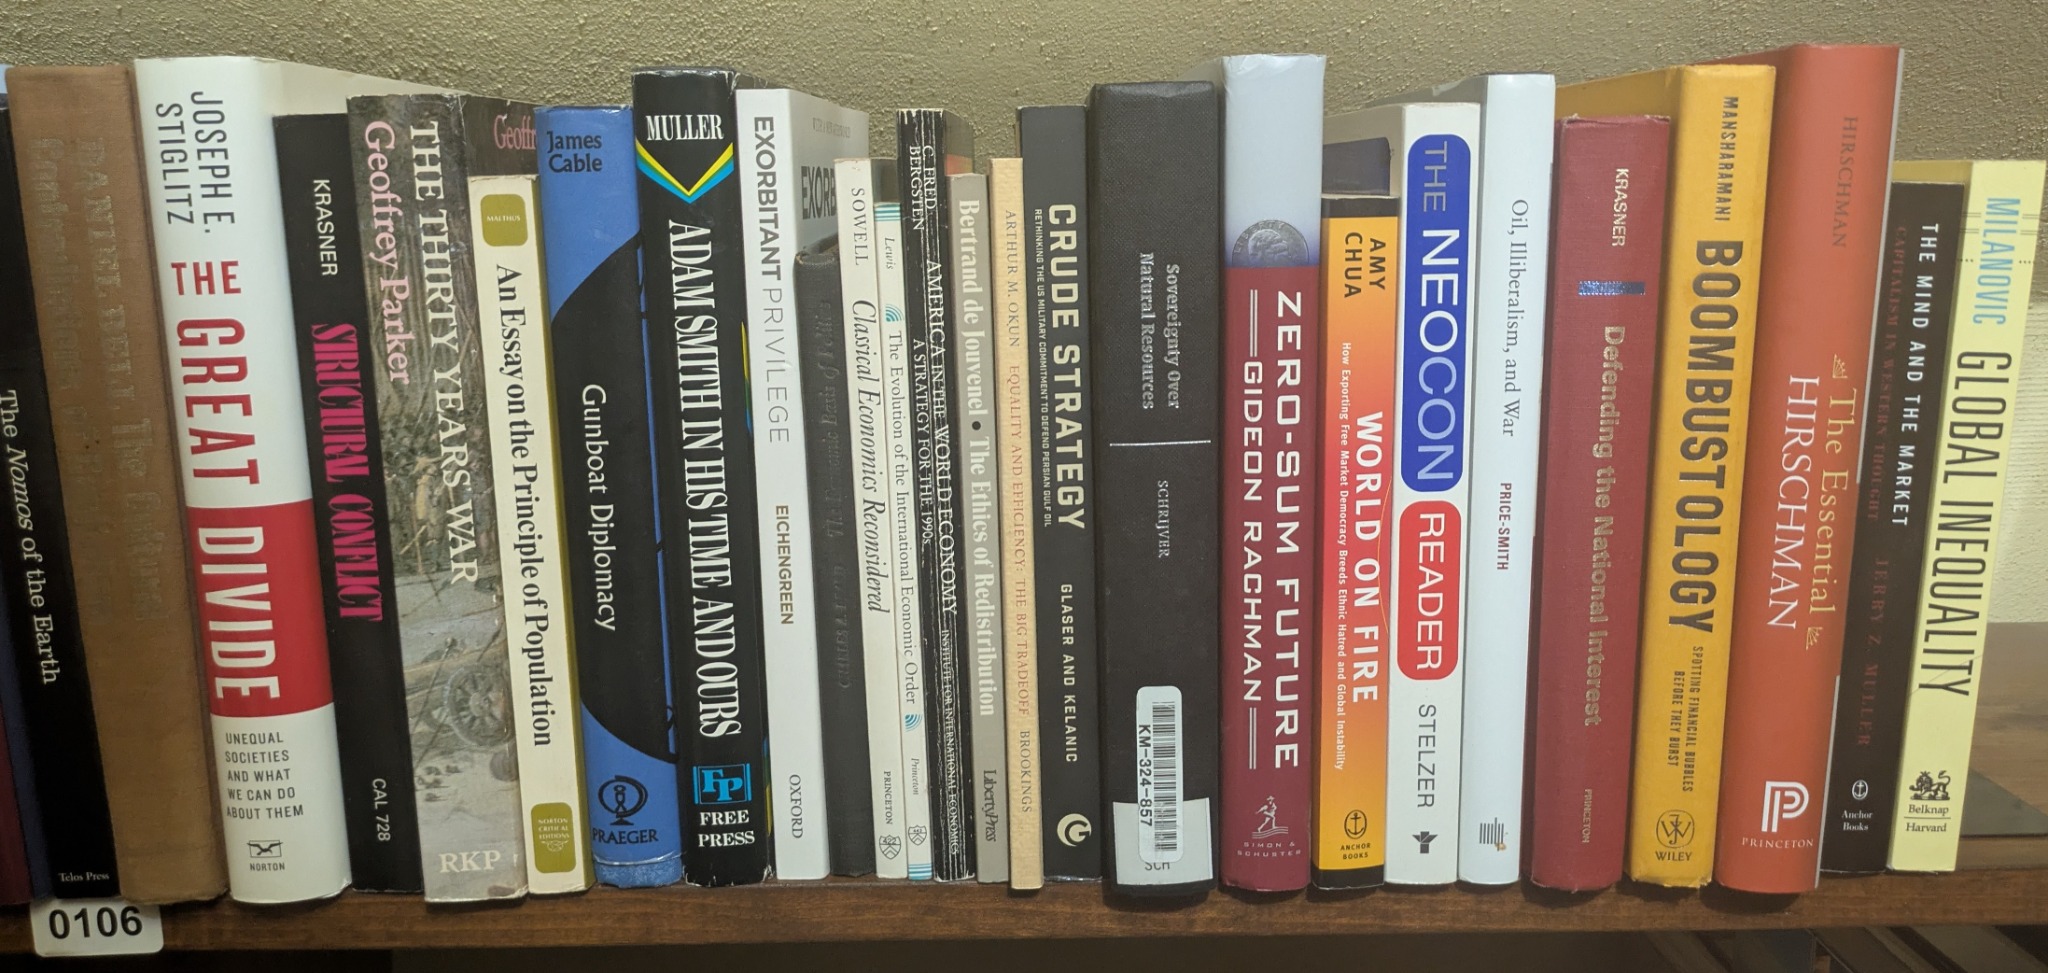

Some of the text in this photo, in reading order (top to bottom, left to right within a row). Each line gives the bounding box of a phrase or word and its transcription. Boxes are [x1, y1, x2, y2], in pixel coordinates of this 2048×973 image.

[156, 104, 194, 224] STIGLITZ
[190, 92, 234, 233] JOSEPH E.
[410, 121, 446, 200] THE
[547, 132, 602, 150] James
[549, 154, 603, 173] Cable
[646, 114, 724, 141] MULLER
[1715, 96, 1739, 222] MANSHARAMANI
[1833, 116, 1858, 248] HIRSCHMAN
[313, 179, 337, 276] KRASNER
[365, 121, 416, 385] Geoffrey Parker
[851, 187, 868, 266] SOWELL
[1612, 168, 1629, 247] KRASNER
[1973, 198, 2020, 324] MILANOVIC
[419, 209, 459, 353] THIRTY
[754, 116, 789, 442] EXORBITANT PRIVILEGE
[958, 200, 988, 415] Bertrand de Jouvenel
[1344, 232, 1362, 298] CHUA
[1369, 238, 1385, 290] AMY
[1417, 141, 1459, 480] THE NEOCON
[1503, 200, 1528, 436] Oil, Illiberalism, and War
[1049, 205, 1085, 529] CRUDE STRATEGY
[1140, 253, 1155, 409] Natural Resources
[1164, 264, 1181, 408] Sovereignty Over
[1892, 224, 1938, 525] THE MIND AND THE MARKET
[172, 261, 280, 699] THE GREAT DIVIDE
[312, 324, 383, 621] STRUCTURAL CONFLICT
[669, 219, 741, 738] ADAM SMITH IN HIS TIME AND OURS
[852, 300, 890, 613] Classical Economics Reconsidered
[1669, 240, 1743, 633] BOOMBUSTOLOGY
[0, 389, 60, 685] The Nomos of the Earth
[446, 499, 478, 585] WAR
[496, 264, 556, 747] An Essay on the Principle of Population
[582, 384, 617, 631] Gunboat Diplomacy
[888, 331, 919, 705] The Evolution of the International Economic Order
[1158, 480, 1169, 558] SCHRIJVER
[1243, 362, 1262, 701] GIDEON RACHMAN
[1275, 291, 1301, 768] ZERO-SUM FUTURE
[1334, 343, 1351, 770] How Exporting Free Market Democracy Breeds Ethnic Hatred and Global Instability
[1497, 483, 1511, 570] PRICE-SMITH
[1585, 327, 1625, 726] Defending the National Interest
[1767, 375, 1819, 629] HIRSCHMAN
[1810, 388, 1856, 615] The Essential
[1919, 352, 2011, 696] GLOBAL INEQUALITY
[775, 505, 794, 625] EICHENGREEN
[970, 436, 998, 716] The Ethics of Redistribution
[1353, 412, 1383, 703] WORLD ON FIRE
[1417, 513, 1445, 670] READER
[1060, 585, 1077, 762] GLASER AND KELANIC
[225, 750, 289, 763] SOCIETIES
[226, 732, 283, 745] UNEQUAL
[228, 769, 290, 782] AND WHAT
[228, 787, 295, 801] WE CAN DO
[1020, 730, 1032, 813] BROOKINGS
[1139, 724, 1152, 827] KM-324-857
[1418, 705, 1436, 808] STELZER
[227, 804, 304, 819] ABOUT THEM
[373, 778, 390, 841] CAL 728
[439, 849, 501, 874] RKP
[592, 828, 658, 845] PRAEGER
[698, 832, 755, 848] PRESS
[699, 810, 749, 826] FREE
[789, 774, 803, 839] OXFORD
[1343, 852, 1368, 860] BOOKS
[1655, 851, 1691, 861] WILEY
[1742, 838, 1814, 849] PRINCETON
[1842, 810, 1873, 820] Anchor
[1843, 823, 1868, 831] Books
[1906, 822, 1947, 832] Harvard
[1908, 804, 1949, 817] Belknap
[58, 871, 109, 882] Telos Press
[250, 862, 285, 871] NORTON
[49, 906, 142, 939] 0106
